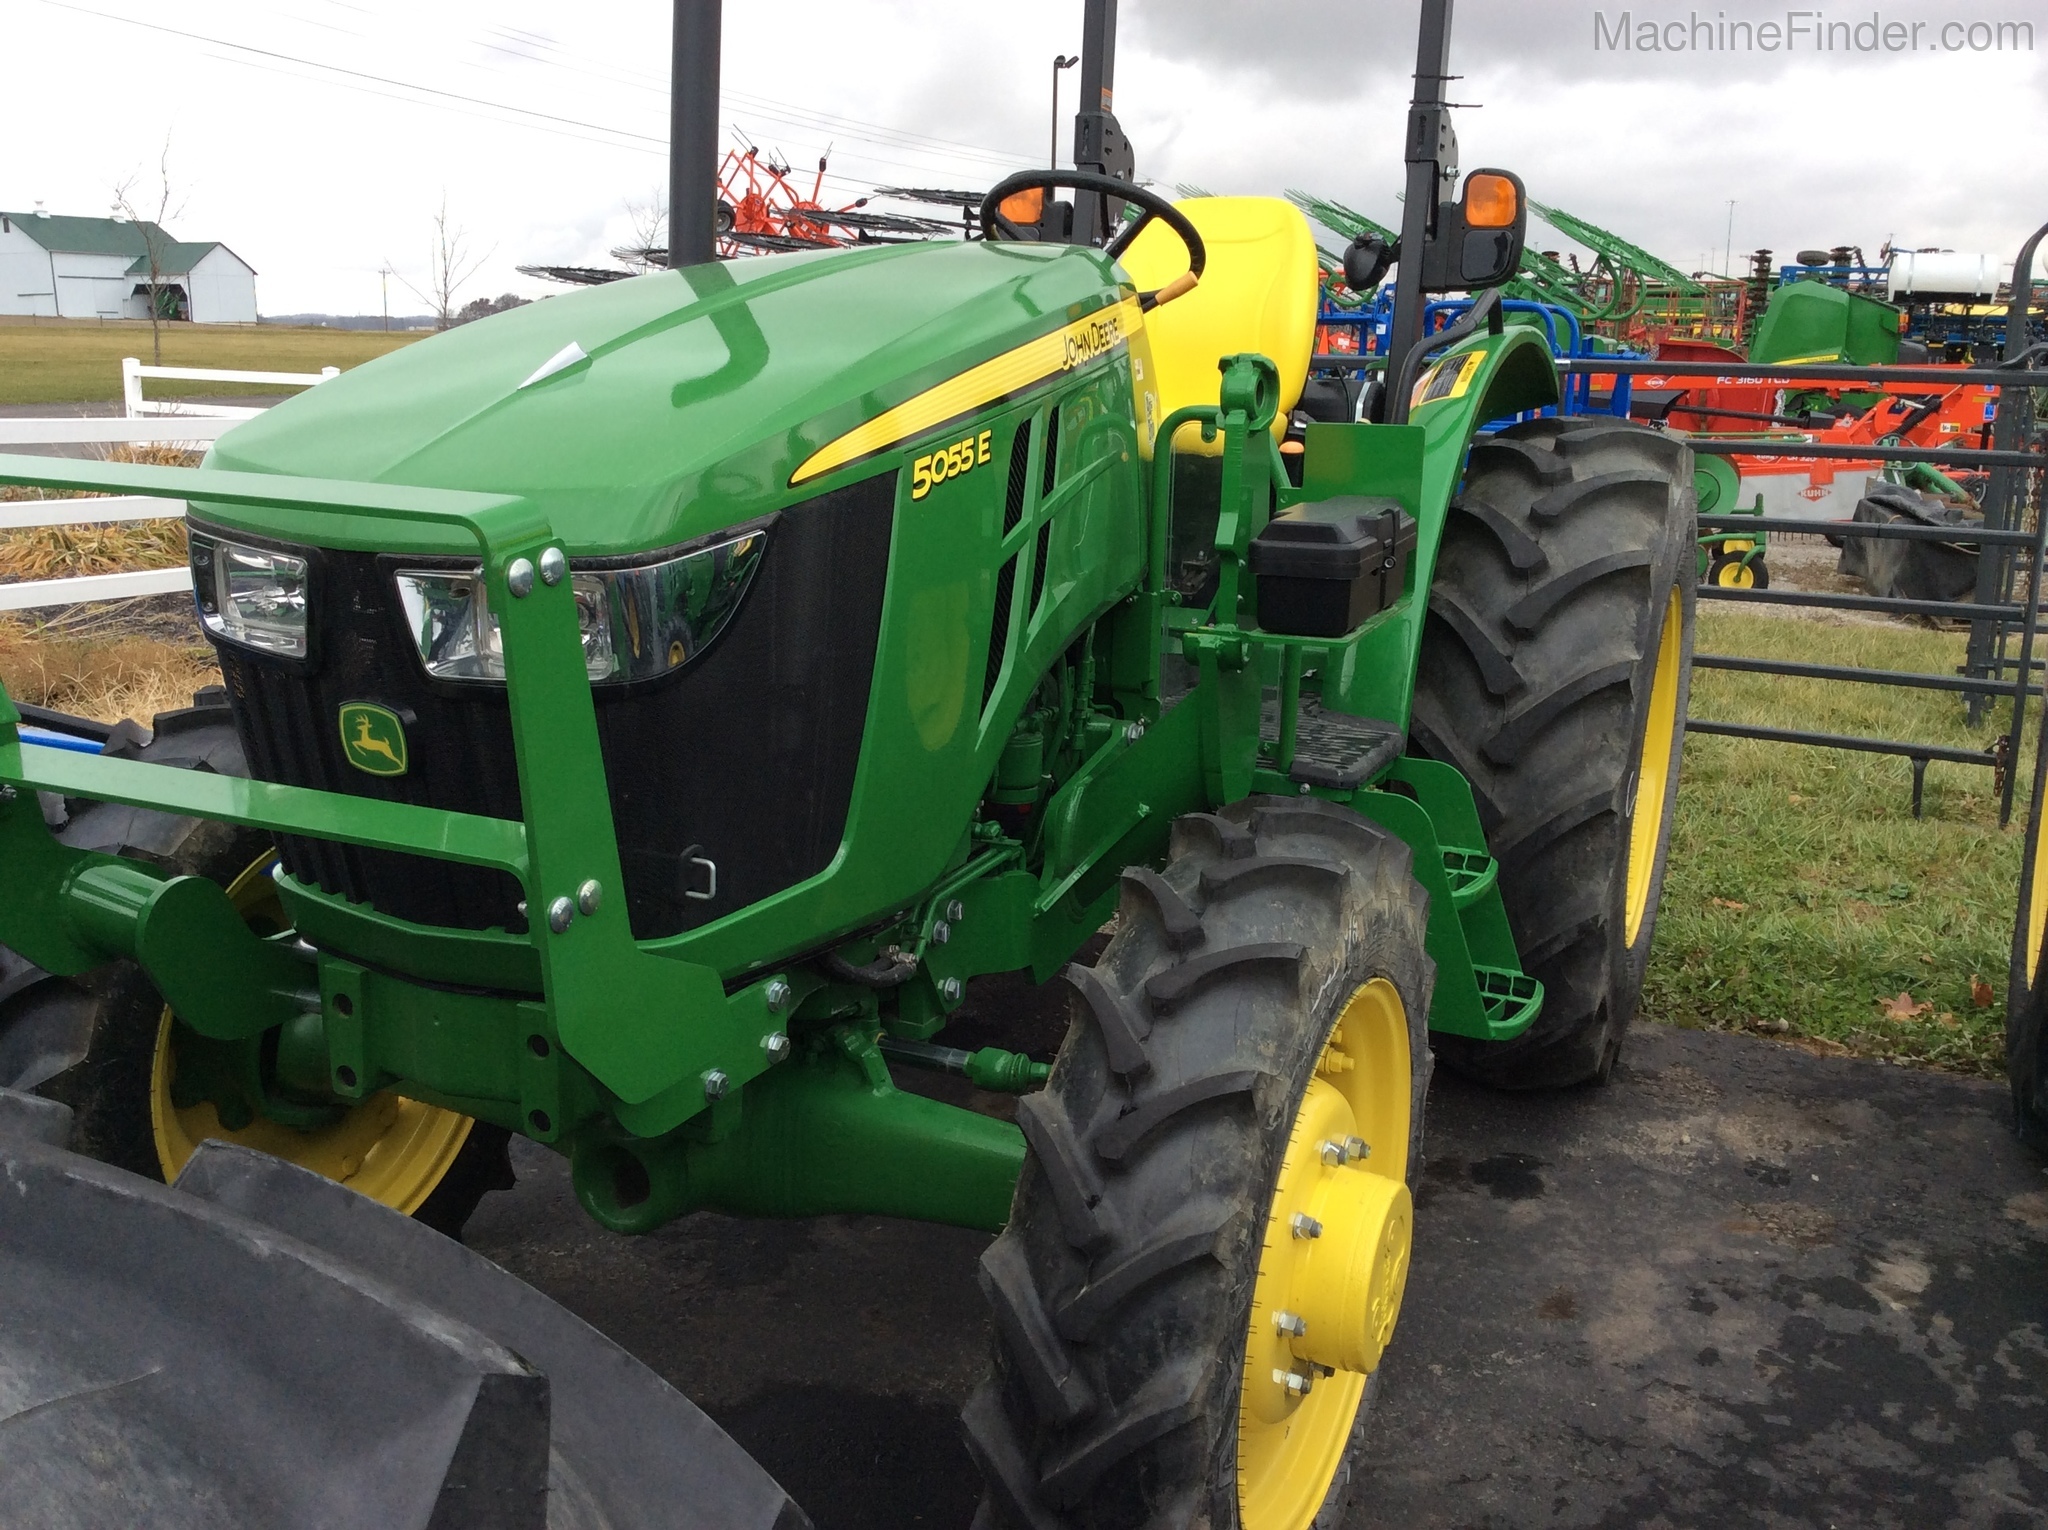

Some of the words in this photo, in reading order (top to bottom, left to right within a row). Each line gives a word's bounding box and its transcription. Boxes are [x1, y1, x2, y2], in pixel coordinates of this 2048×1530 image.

[1062, 331, 1092, 368] JOHN
[1091, 317, 1120, 353] DEERE
[1716, 376, 1733, 385] FC
[1736, 376, 1764, 385] 3160
[912, 436, 975, 501] 5055
[1800, 488, 1829, 498] KUHN
